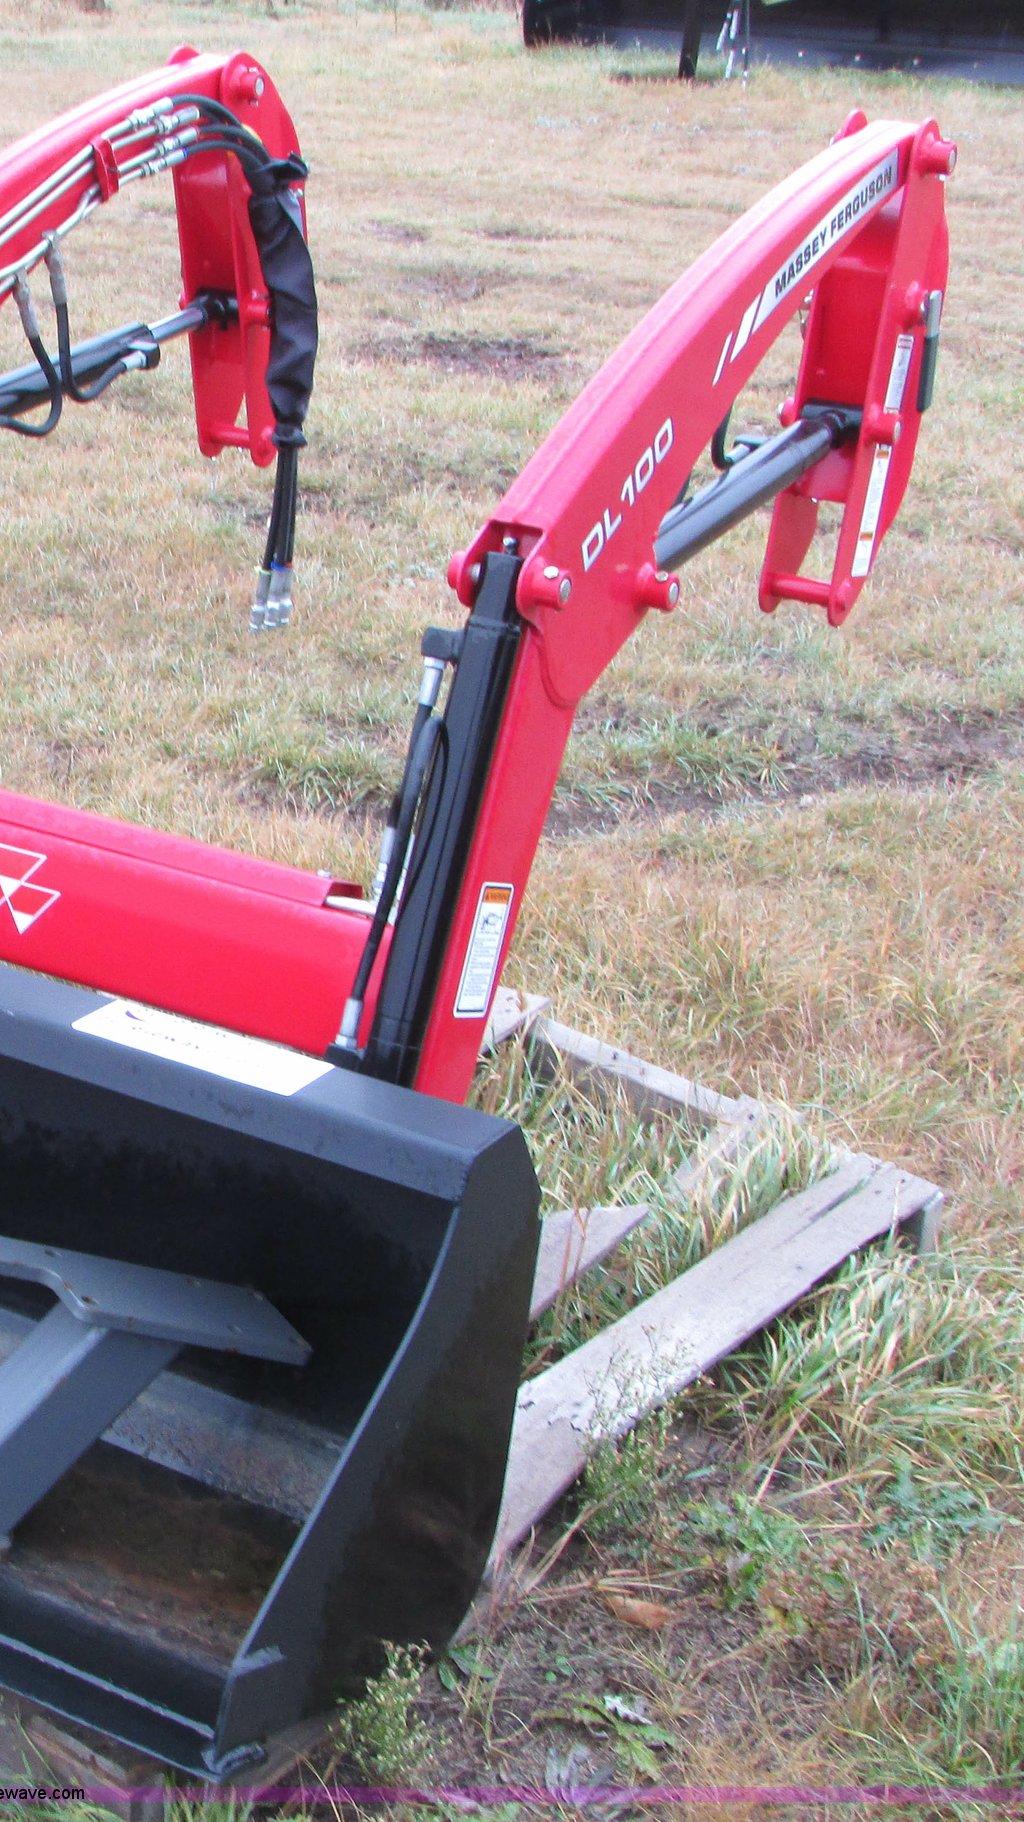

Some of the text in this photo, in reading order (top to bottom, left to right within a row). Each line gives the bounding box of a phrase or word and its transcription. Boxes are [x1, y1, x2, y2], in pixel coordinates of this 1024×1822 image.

[775, 166, 892, 298] MASSEY FERGUSON
[581, 417, 674, 572] DL 100
